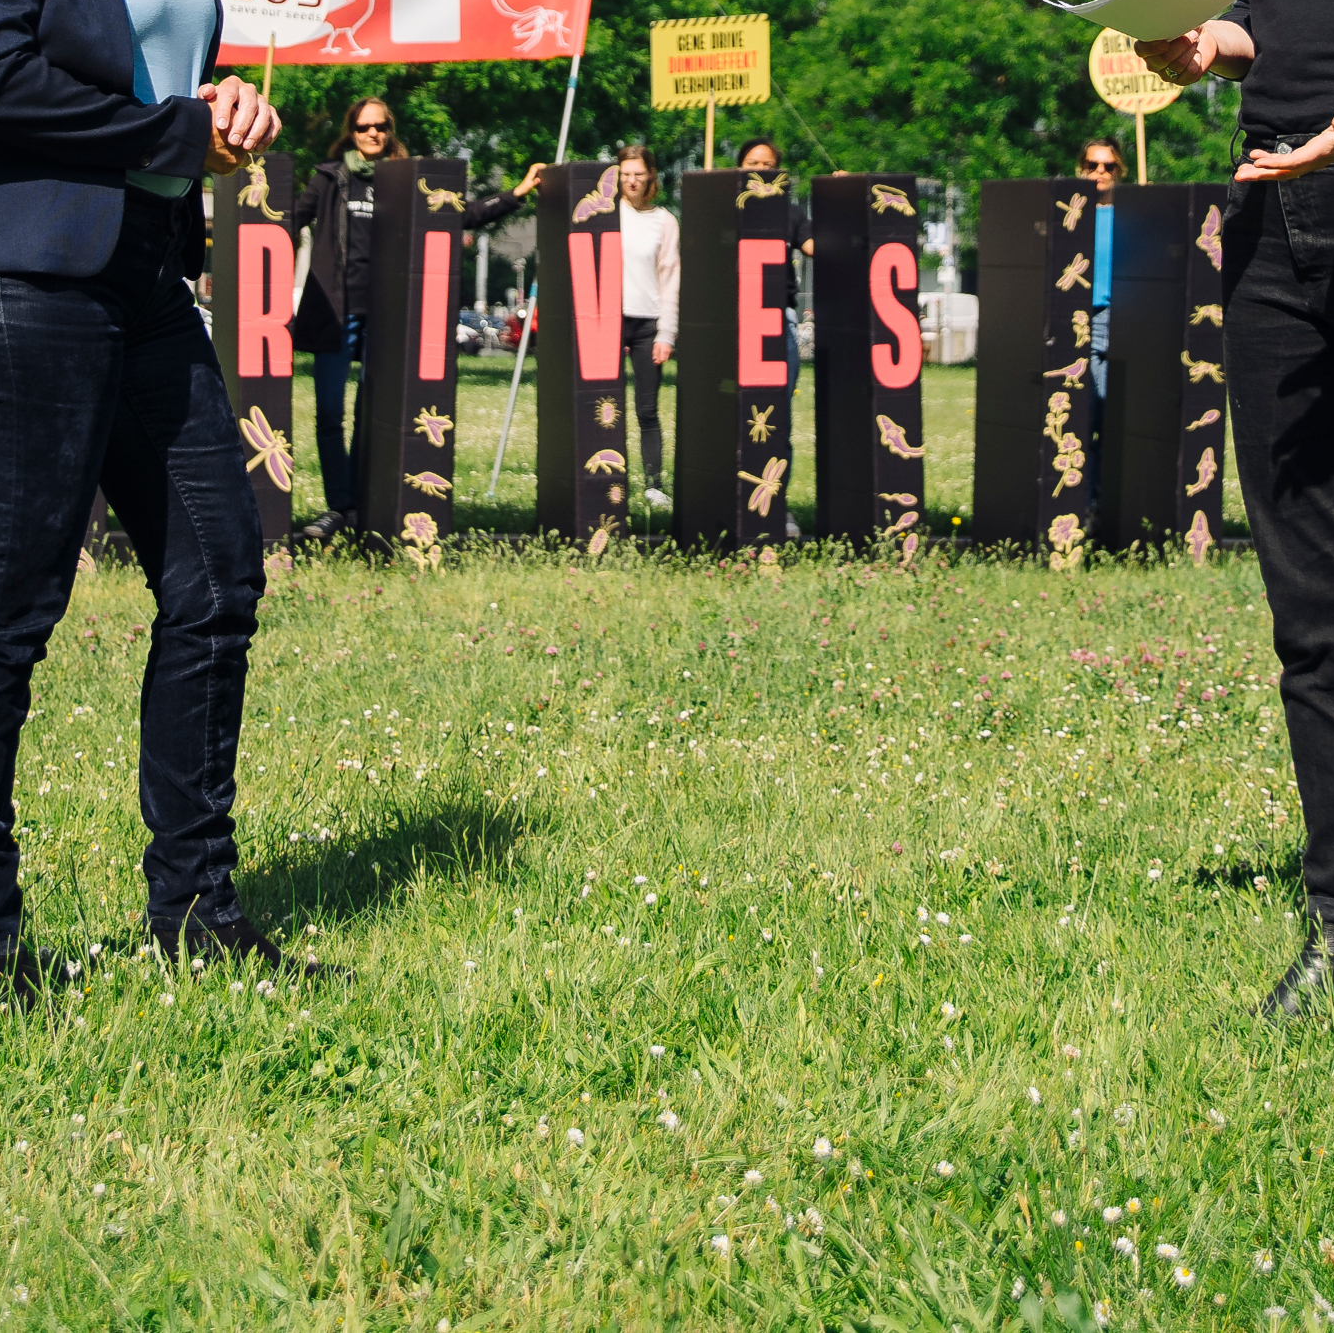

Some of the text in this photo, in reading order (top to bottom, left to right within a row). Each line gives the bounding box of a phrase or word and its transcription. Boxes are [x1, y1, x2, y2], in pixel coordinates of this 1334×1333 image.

[230, 3, 322, 23] save our seeds
[677, 29, 745, 52] GENE DRIVE
[237, 222, 923, 390] RIVES
